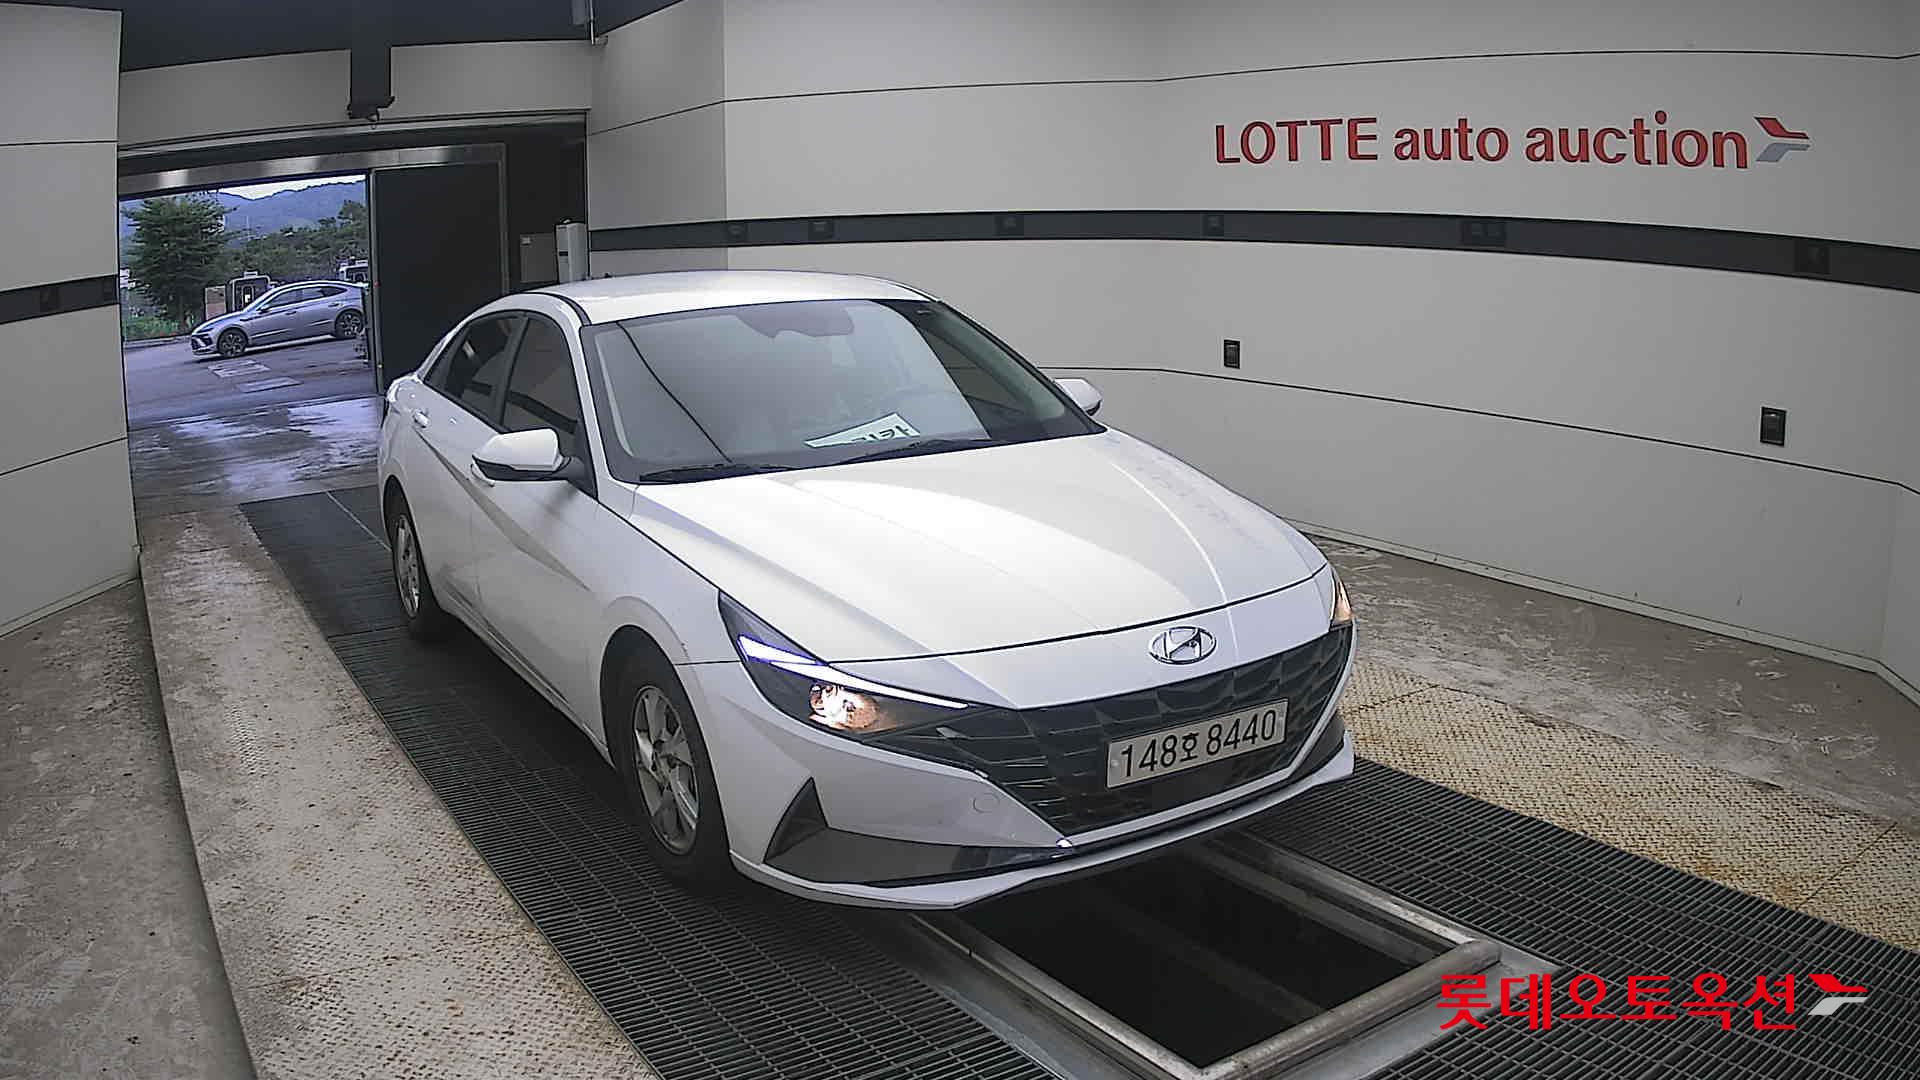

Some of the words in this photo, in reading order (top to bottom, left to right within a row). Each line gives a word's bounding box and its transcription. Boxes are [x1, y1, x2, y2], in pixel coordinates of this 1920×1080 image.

[1215, 117, 1378, 164] LOTTE
[1394, 118, 1510, 162] auto
[1525, 110, 1748, 169] auction
[1121, 732, 1200, 778] 148호
[1206, 709, 1277, 756] 8440
